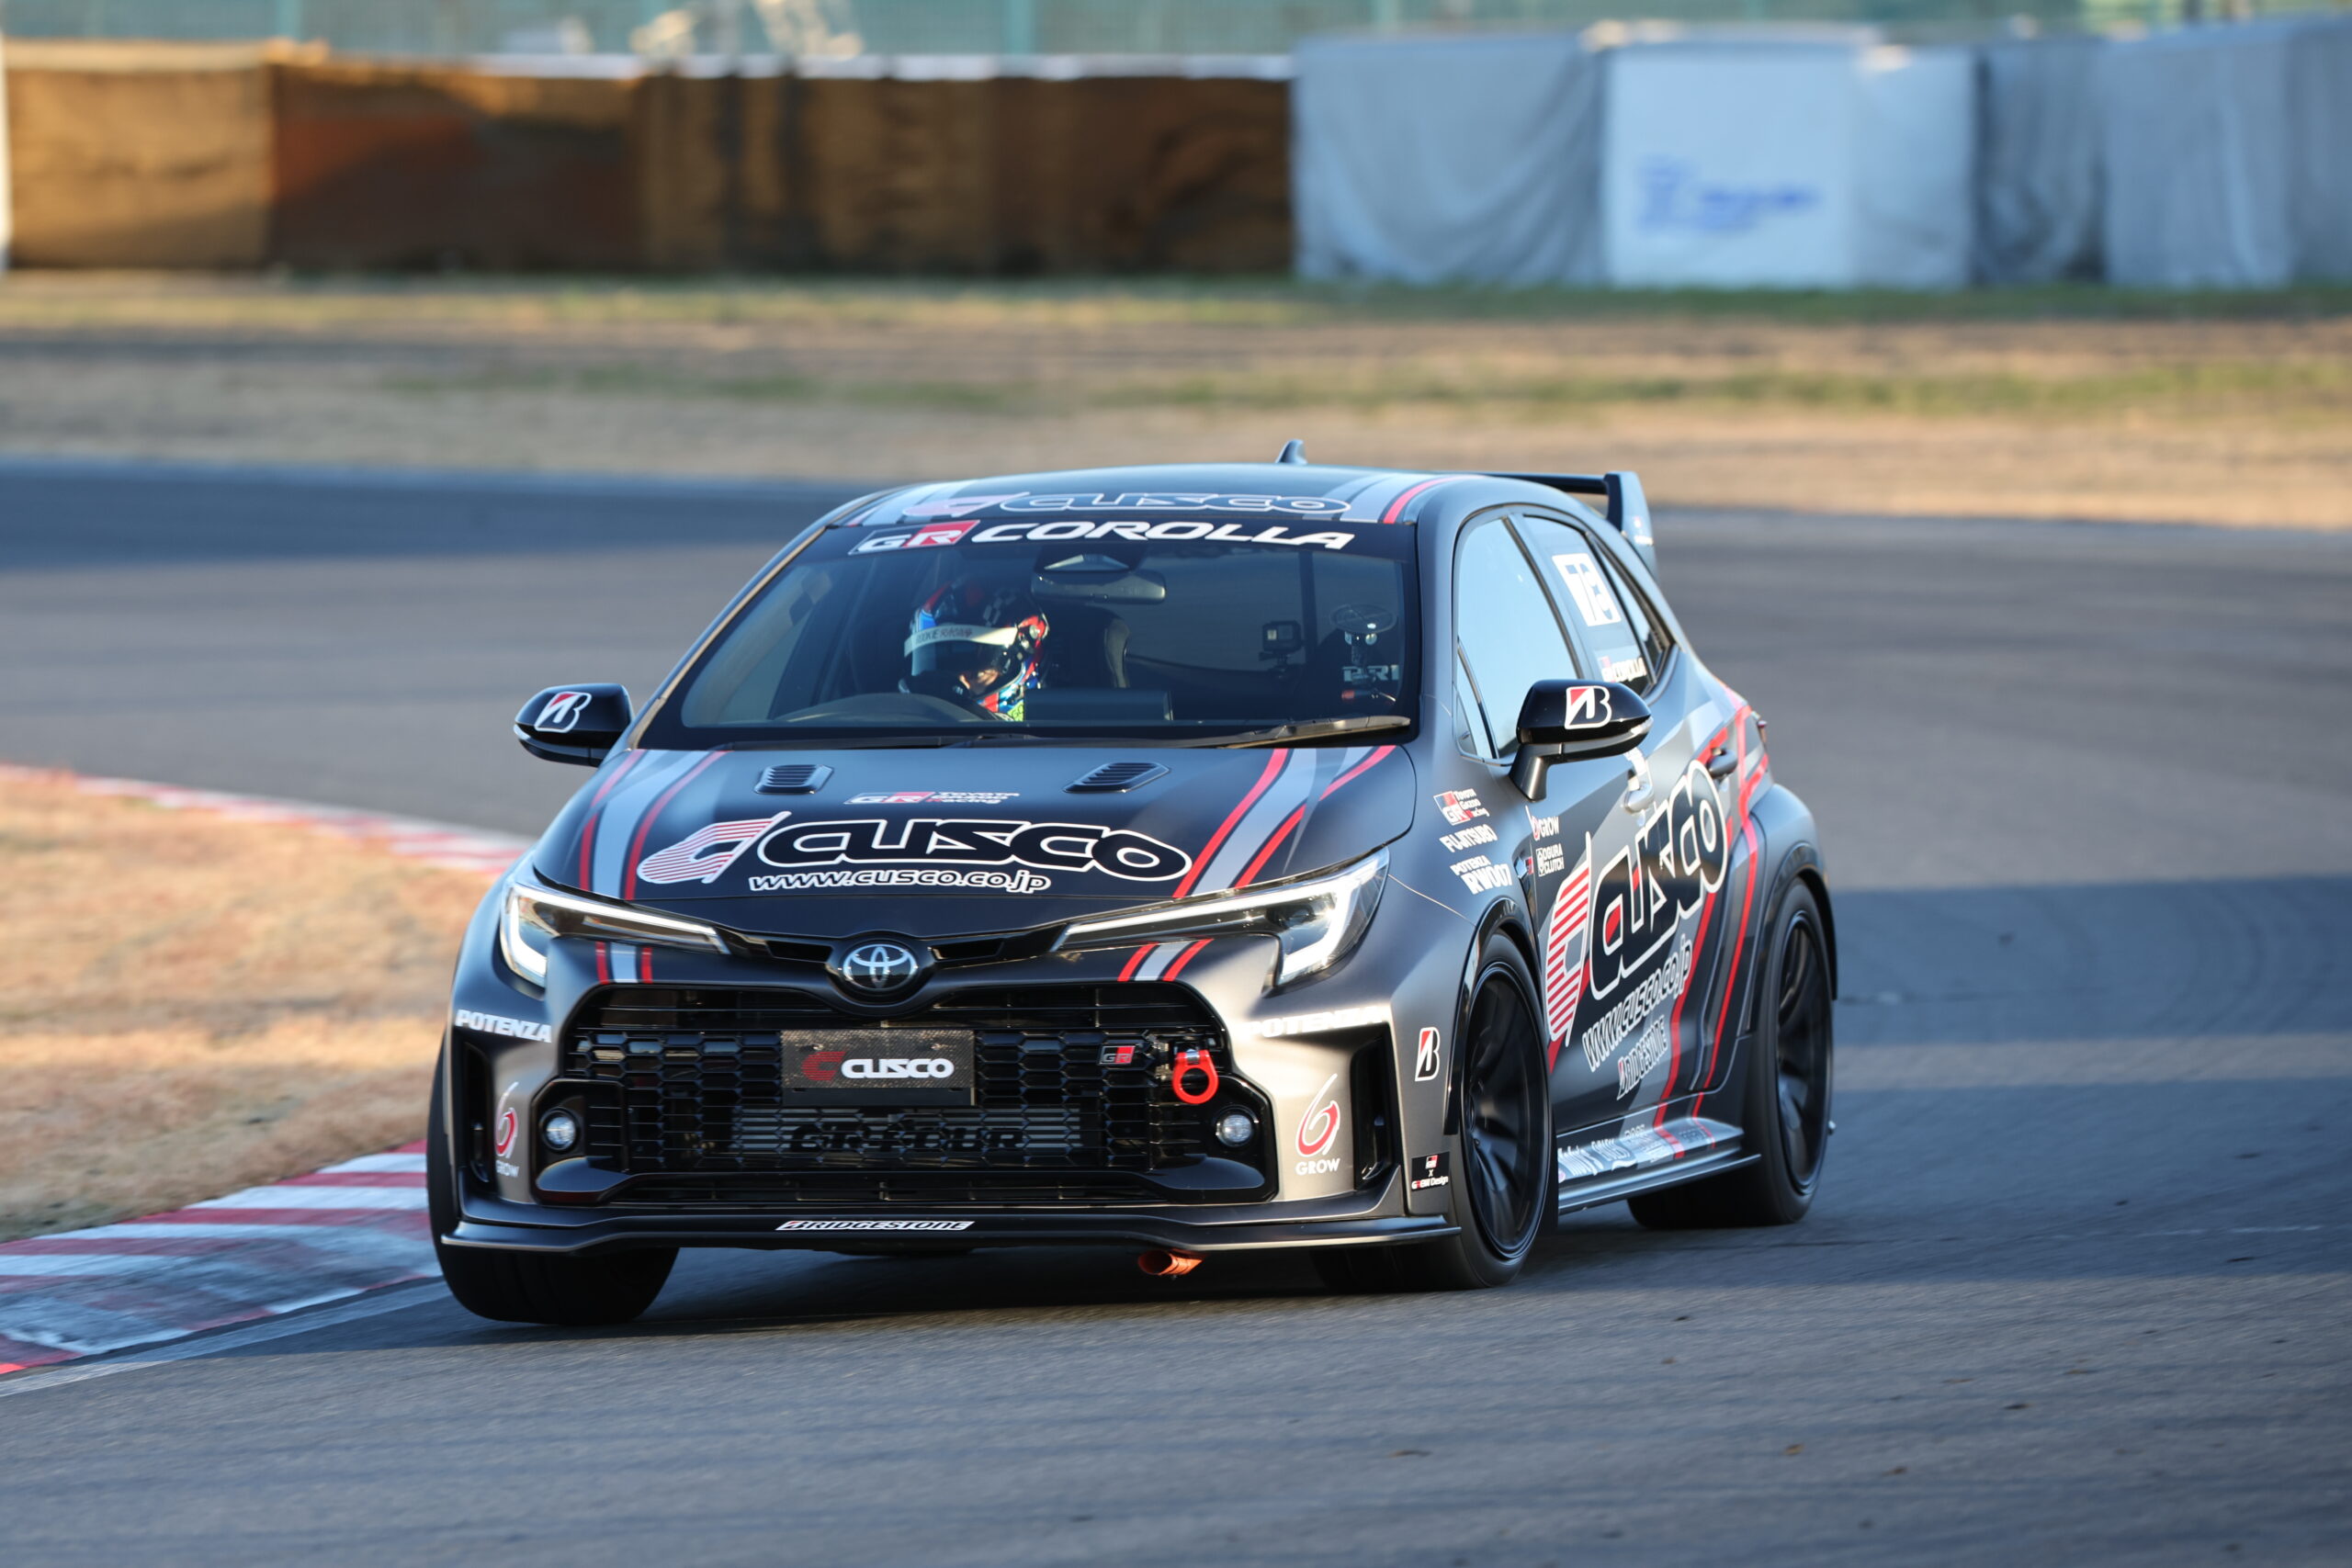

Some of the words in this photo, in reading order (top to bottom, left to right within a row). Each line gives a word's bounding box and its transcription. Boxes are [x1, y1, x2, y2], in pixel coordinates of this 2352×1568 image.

[856, 528, 967, 552] GR
[971, 522, 1355, 550] COROLLA
[1439, 824, 1498, 853] FUJITSUBO
[1538, 816, 1560, 839] GROW
[756, 818, 1193, 881] CUSCO
[1542, 843, 1564, 858] OGURA
[1449, 854, 1491, 876] POTENZA
[1544, 856, 1566, 874] CLUTCH
[748, 869, 1052, 893] www.cusco.co.jp
[1461, 863, 1513, 895] RW007
[1581, 933, 1693, 1073] www.cusco.co.jp
[455, 1009, 552, 1043] POTENZA
[841, 1058, 955, 1078] CUSCO
[1295, 1158, 1340, 1176] GROW
[775, 1221, 976, 1231] BRIDGESTONE
